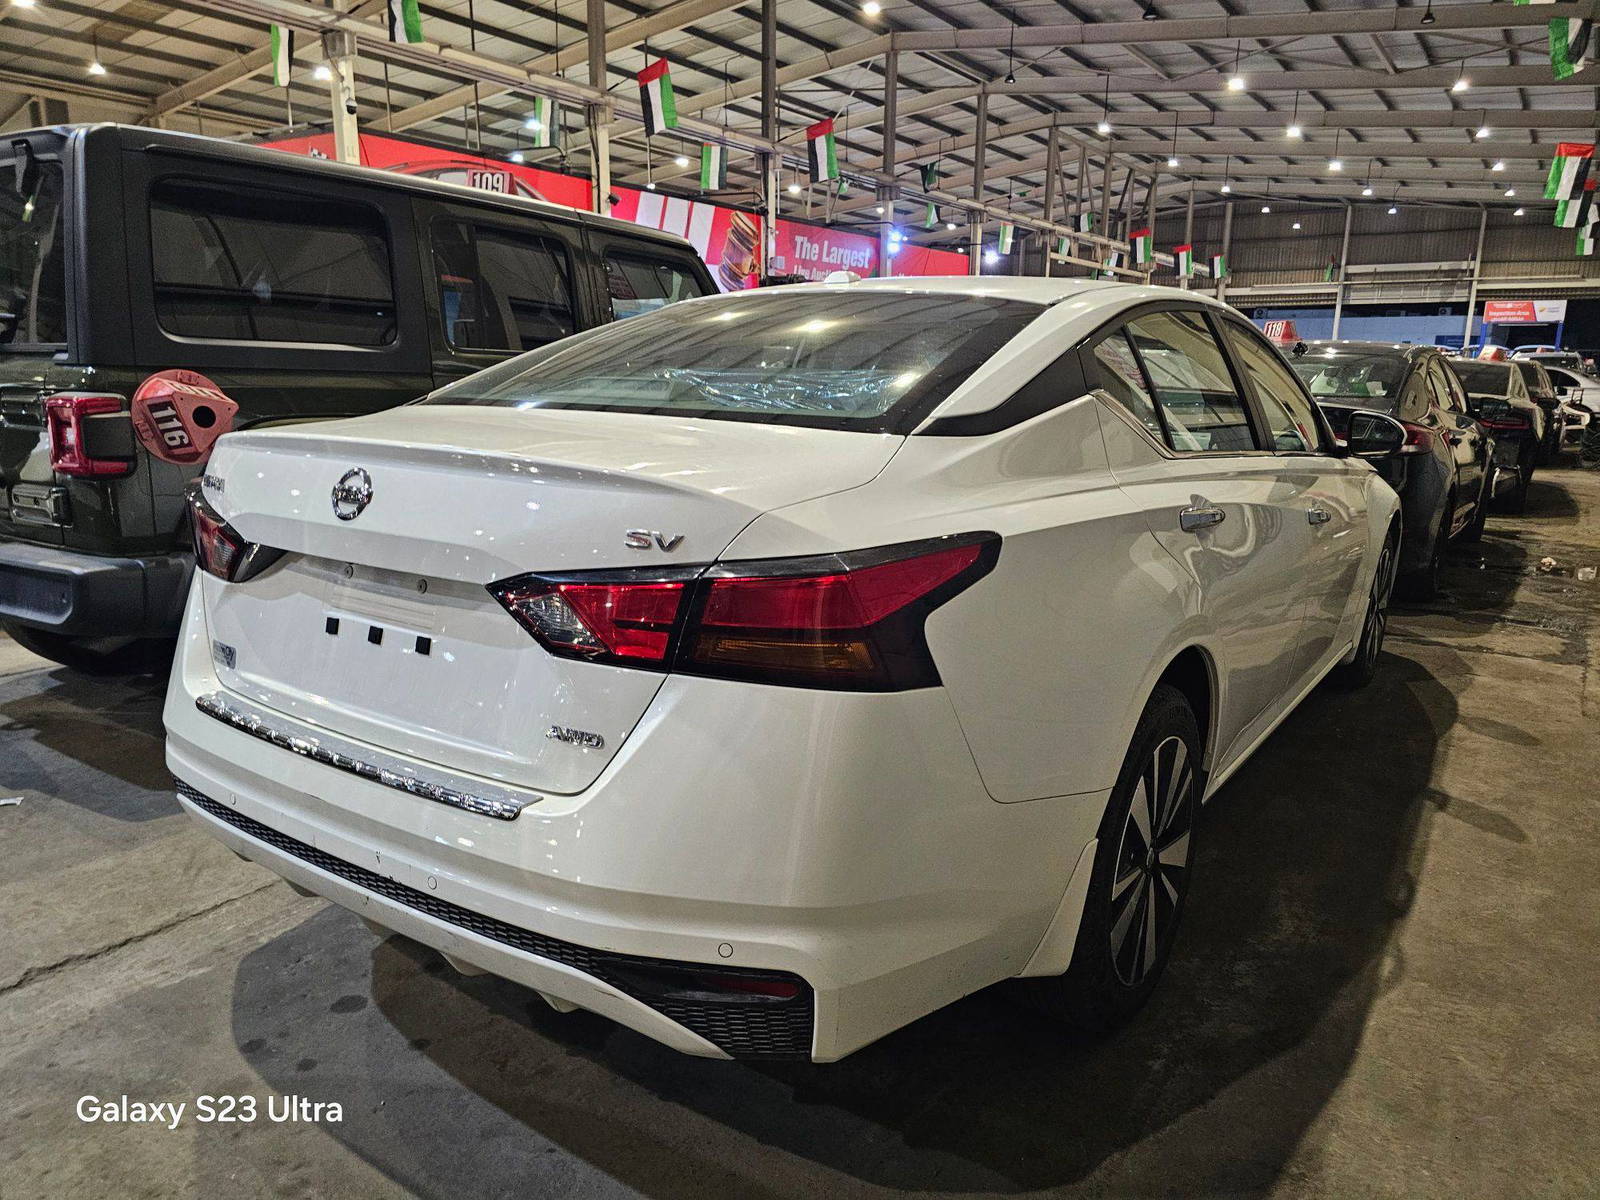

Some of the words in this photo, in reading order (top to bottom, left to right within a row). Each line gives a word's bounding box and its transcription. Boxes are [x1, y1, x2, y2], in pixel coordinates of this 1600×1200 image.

[474, 172, 503, 192] 109
[795, 236, 819, 261] The
[822, 240, 871, 270] Largest
[151, 406, 189, 446] 116
[624, 529, 684, 552] SV
[546, 725, 605, 749] AWD
